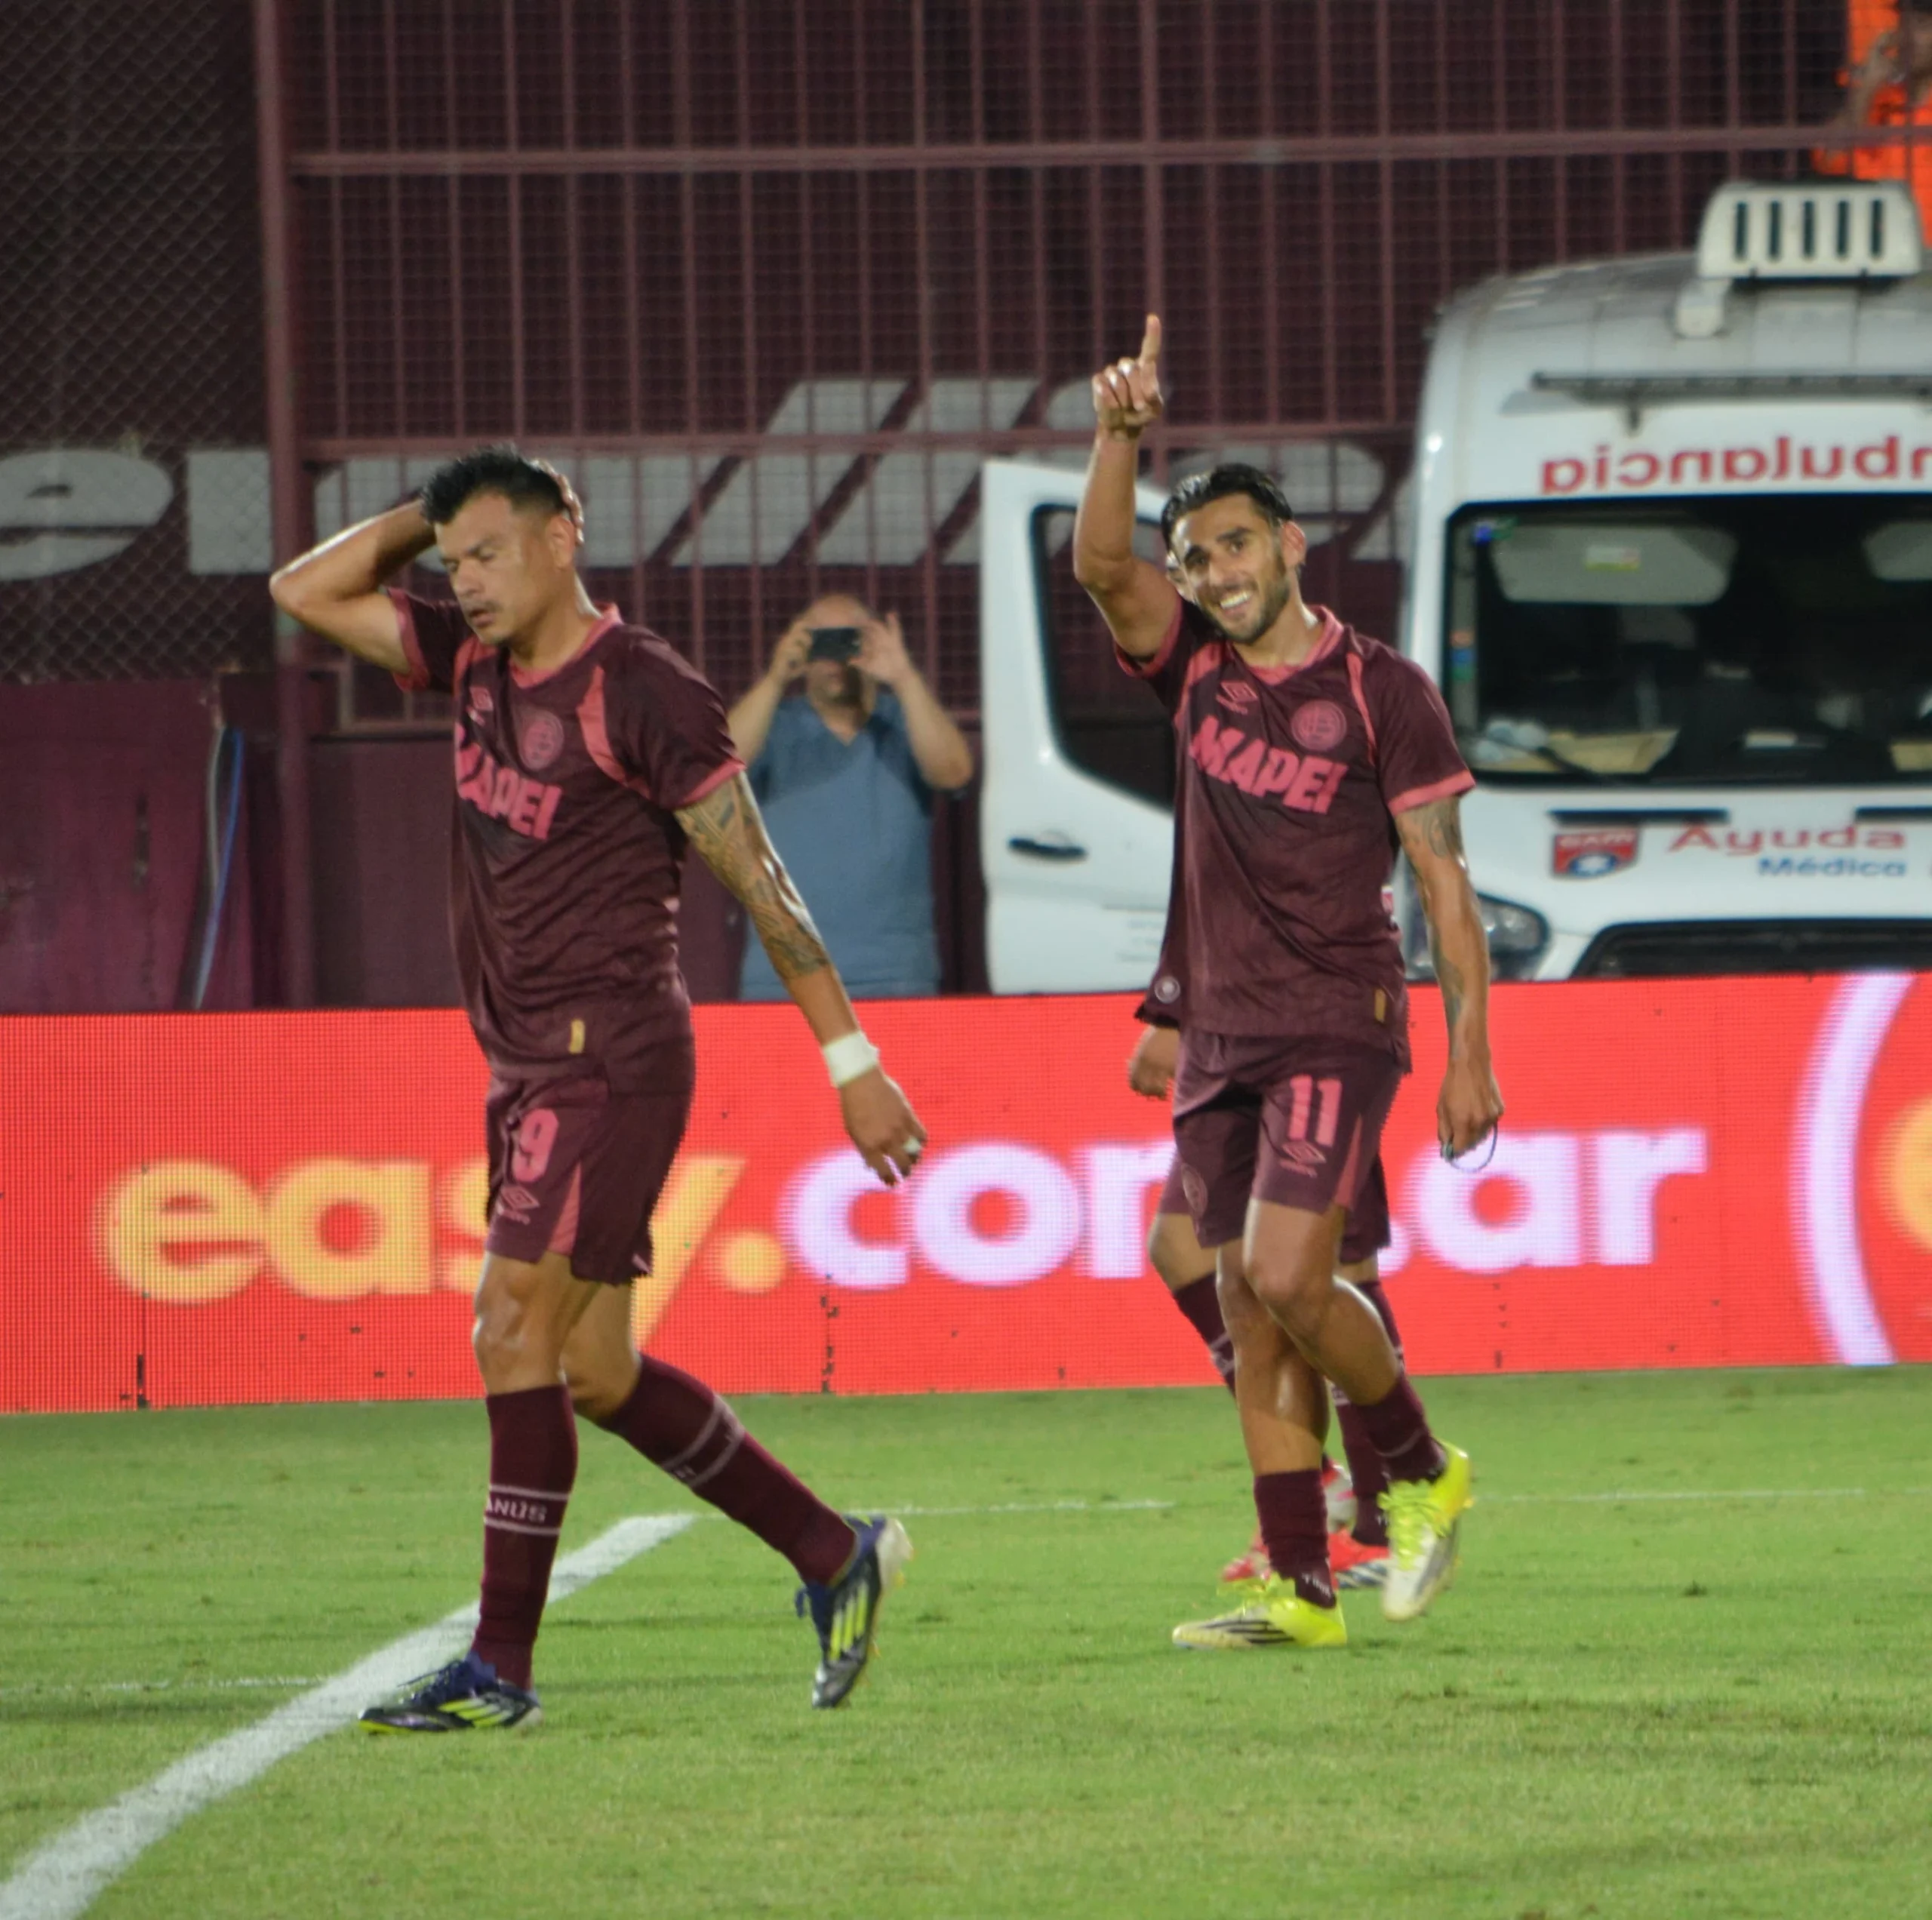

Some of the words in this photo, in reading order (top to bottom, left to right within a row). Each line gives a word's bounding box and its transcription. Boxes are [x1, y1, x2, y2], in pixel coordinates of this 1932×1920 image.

[1190, 714, 1349, 815] MAPEI
[1668, 820, 1905, 856] Ayuda
[1757, 855, 1906, 877] Médica
[512, 1107, 559, 1183] 9
[1287, 1075, 1343, 1147] 11
